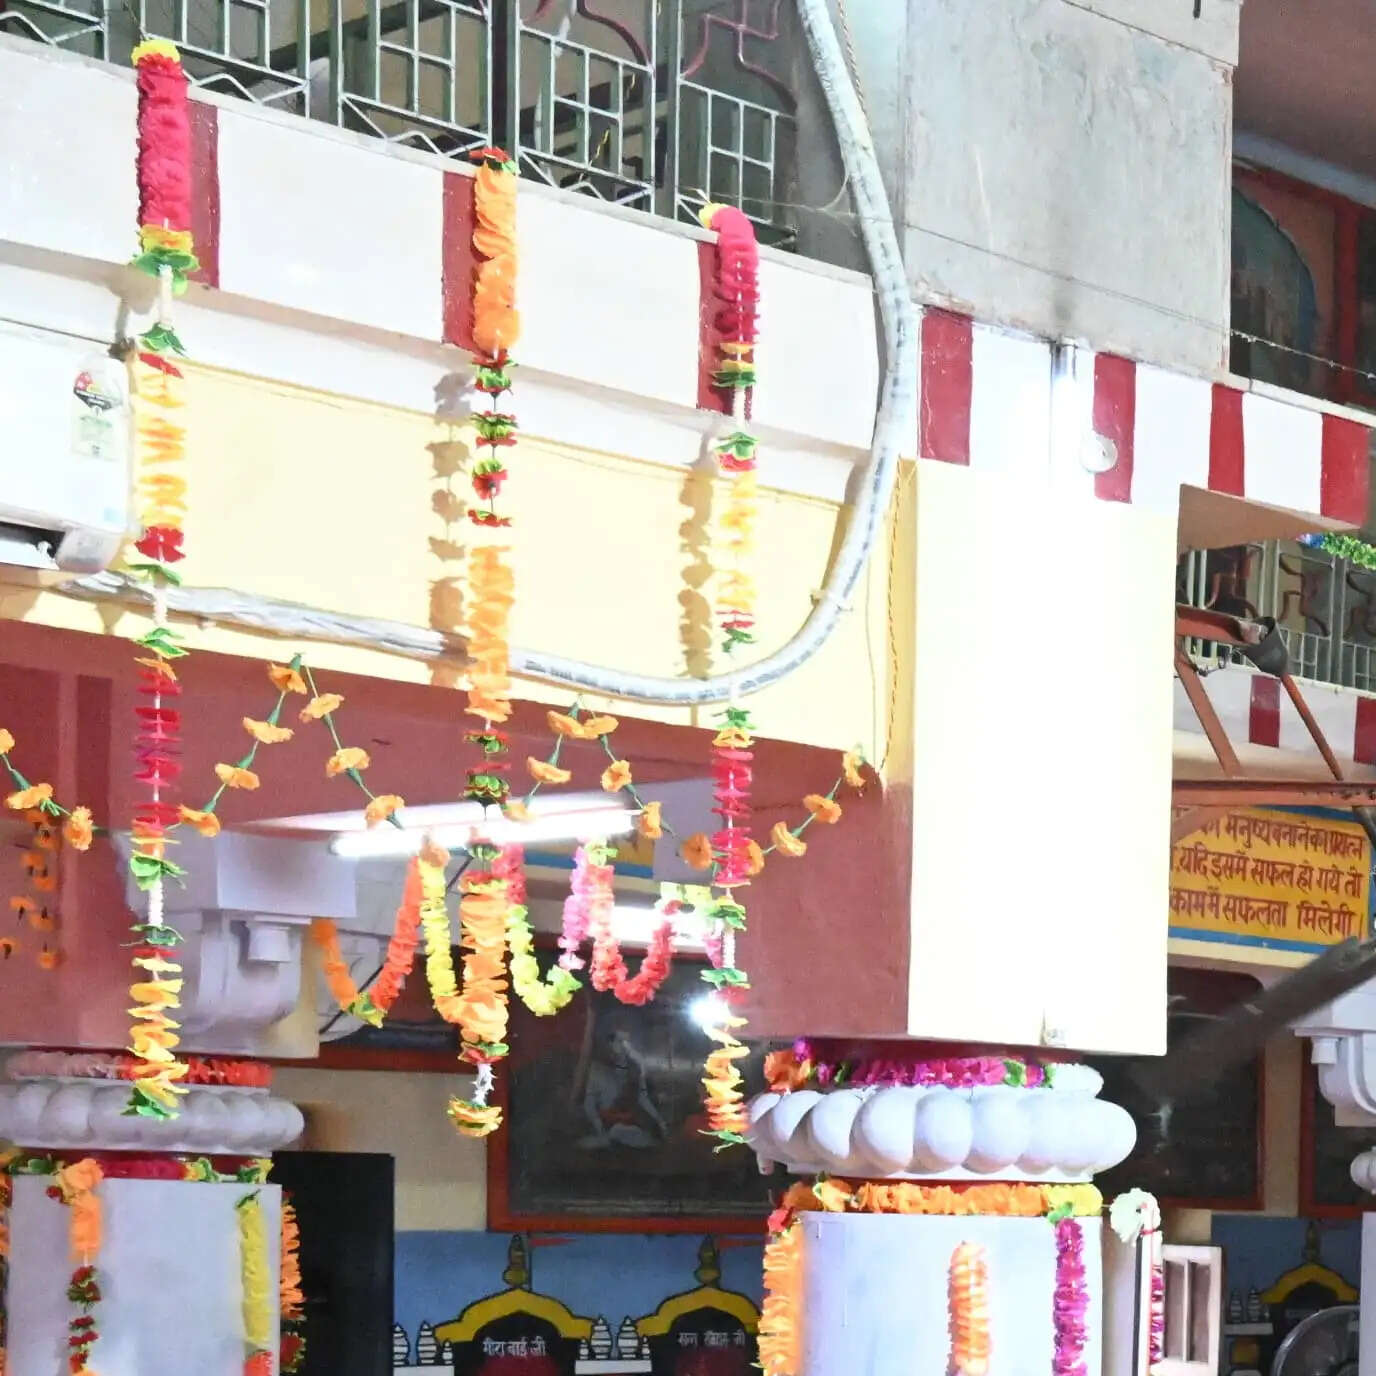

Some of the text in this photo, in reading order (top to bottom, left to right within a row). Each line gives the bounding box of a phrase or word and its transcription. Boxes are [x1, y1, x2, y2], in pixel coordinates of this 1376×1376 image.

[1179, 841, 1209, 880] यदि
[1250, 857, 1296, 890] सफल
[1296, 859, 1313, 893] हो
[1315, 864, 1345, 896] गये
[1344, 866, 1364, 900] तो
[1172, 888, 1205, 917] काम
[1222, 894, 1289, 929] सफलता
[1296, 900, 1357, 938] मिलेगी
[530, 1335, 545, 1356] जी
